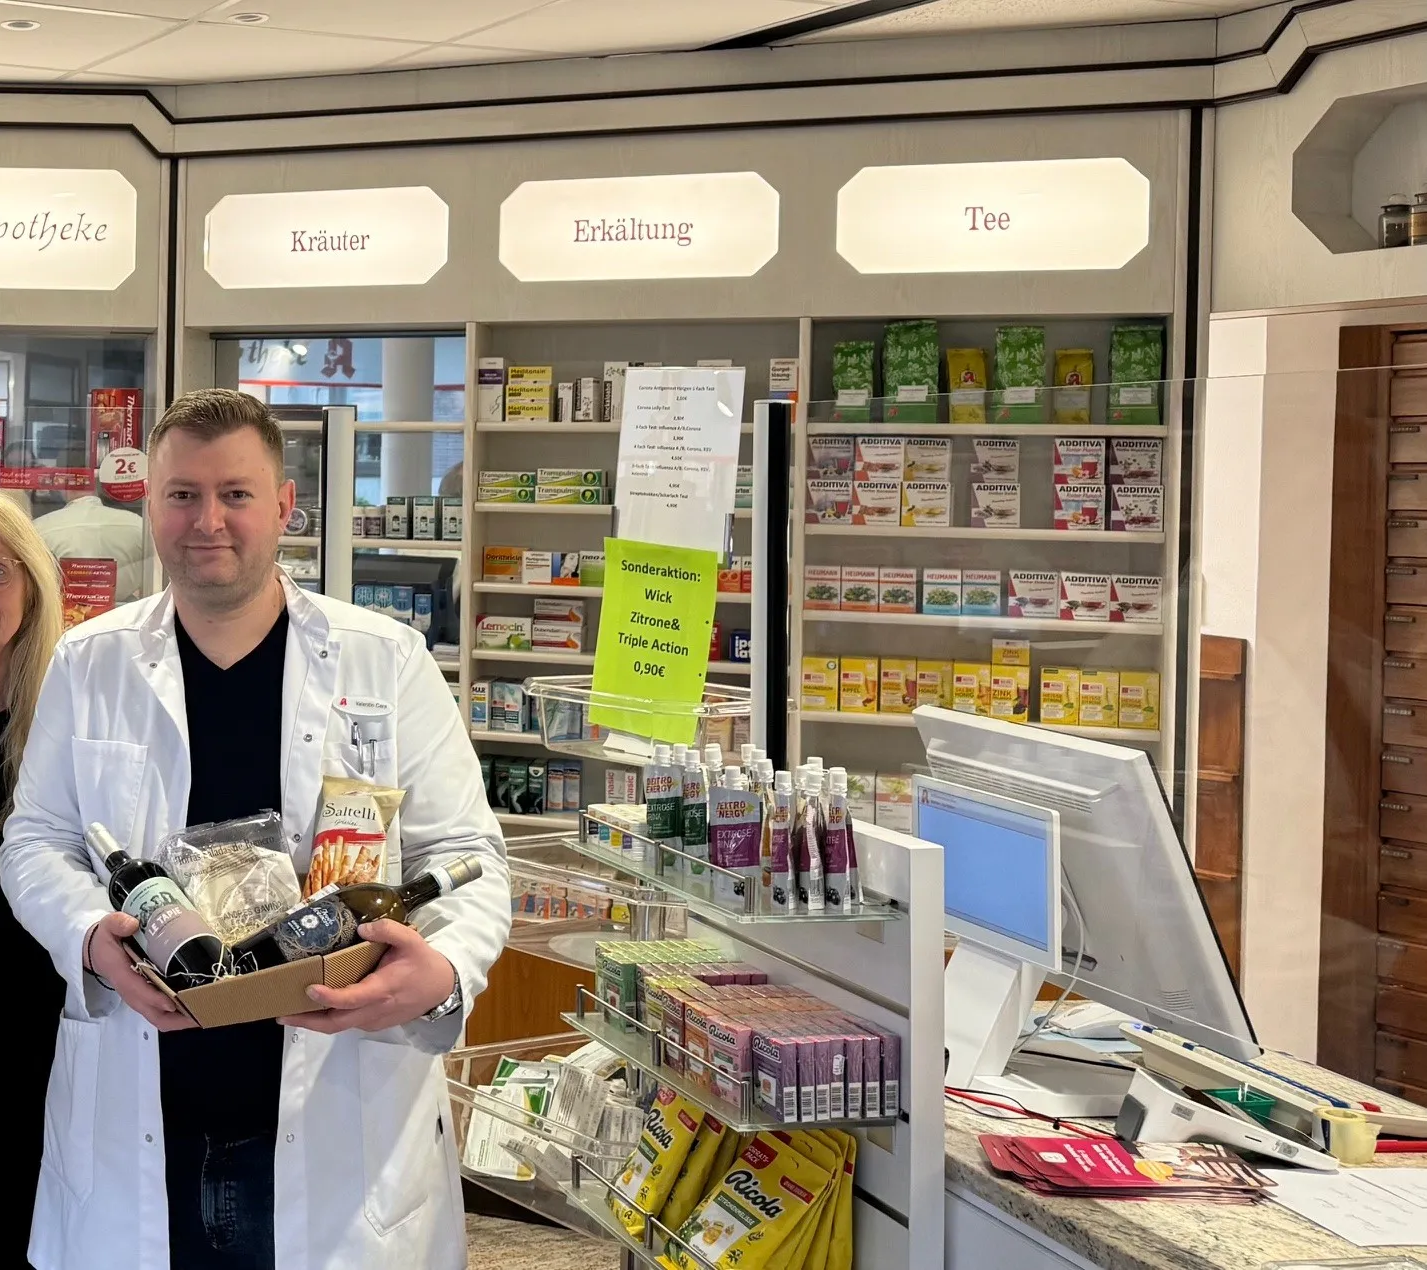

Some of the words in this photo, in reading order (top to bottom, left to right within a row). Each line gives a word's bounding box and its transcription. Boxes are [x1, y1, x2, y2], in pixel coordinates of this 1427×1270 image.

[965, 206, 1010, 232] Tee
[573, 215, 694, 246] Erkältung
[290, 228, 370, 254] Kräuter
[861, 438, 901, 446] ADDITIVA
[976, 440, 1018, 448] ADDITIVA
[1059, 440, 1104, 448] ADDITIVA
[1115, 440, 1161, 448] ADDITIVA
[115, 459, 136, 474] 2€
[810, 481, 851, 489] ADDITIVA
[857, 482, 899, 490] ADDITIVA
[1116, 486, 1162, 494] ADDITIVA
[621, 560, 701, 583] Sonderaktion:
[1013, 573, 1057, 581] ADDITIVA
[1115, 577, 1162, 585] ADDITIVA
[645, 588, 673, 604] Wick
[481, 621, 523, 632] Lemocin
[630, 611, 680, 631] Zitrone&
[618, 632, 648, 649] Triple
[651, 638, 689, 656] Action
[633, 660, 666, 678] 0,90€
[646, 785, 672, 794] ENERGY
[325, 802, 377, 821] Saltelli
[149, 923, 159, 936] LE
[157, 906, 182, 924] TAPIE
[686, 1008, 707, 1029] Ricola
[709, 1023, 736, 1045] Ricola
[753, 1036, 780, 1059] Ricola
[646, 1108, 673, 1149] Ricola
[725, 1170, 784, 1218] Ricola
